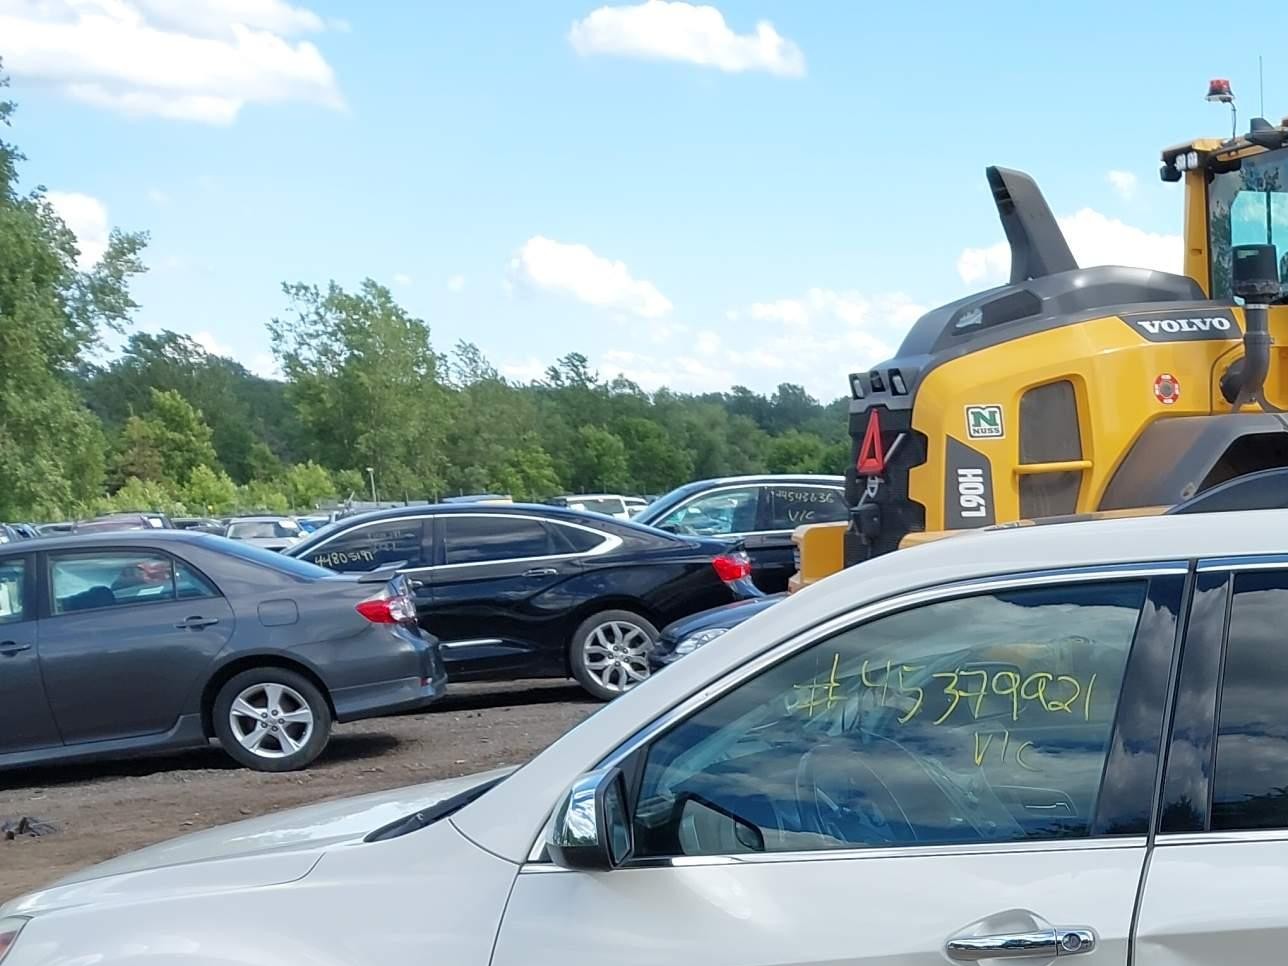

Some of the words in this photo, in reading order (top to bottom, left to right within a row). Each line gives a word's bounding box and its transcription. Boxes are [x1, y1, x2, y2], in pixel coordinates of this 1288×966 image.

[1137, 317, 1231, 334] VOLVO
[970, 410, 999, 428] N
[972, 427, 1000, 435] NUSS
[957, 468, 987, 518] L90H
